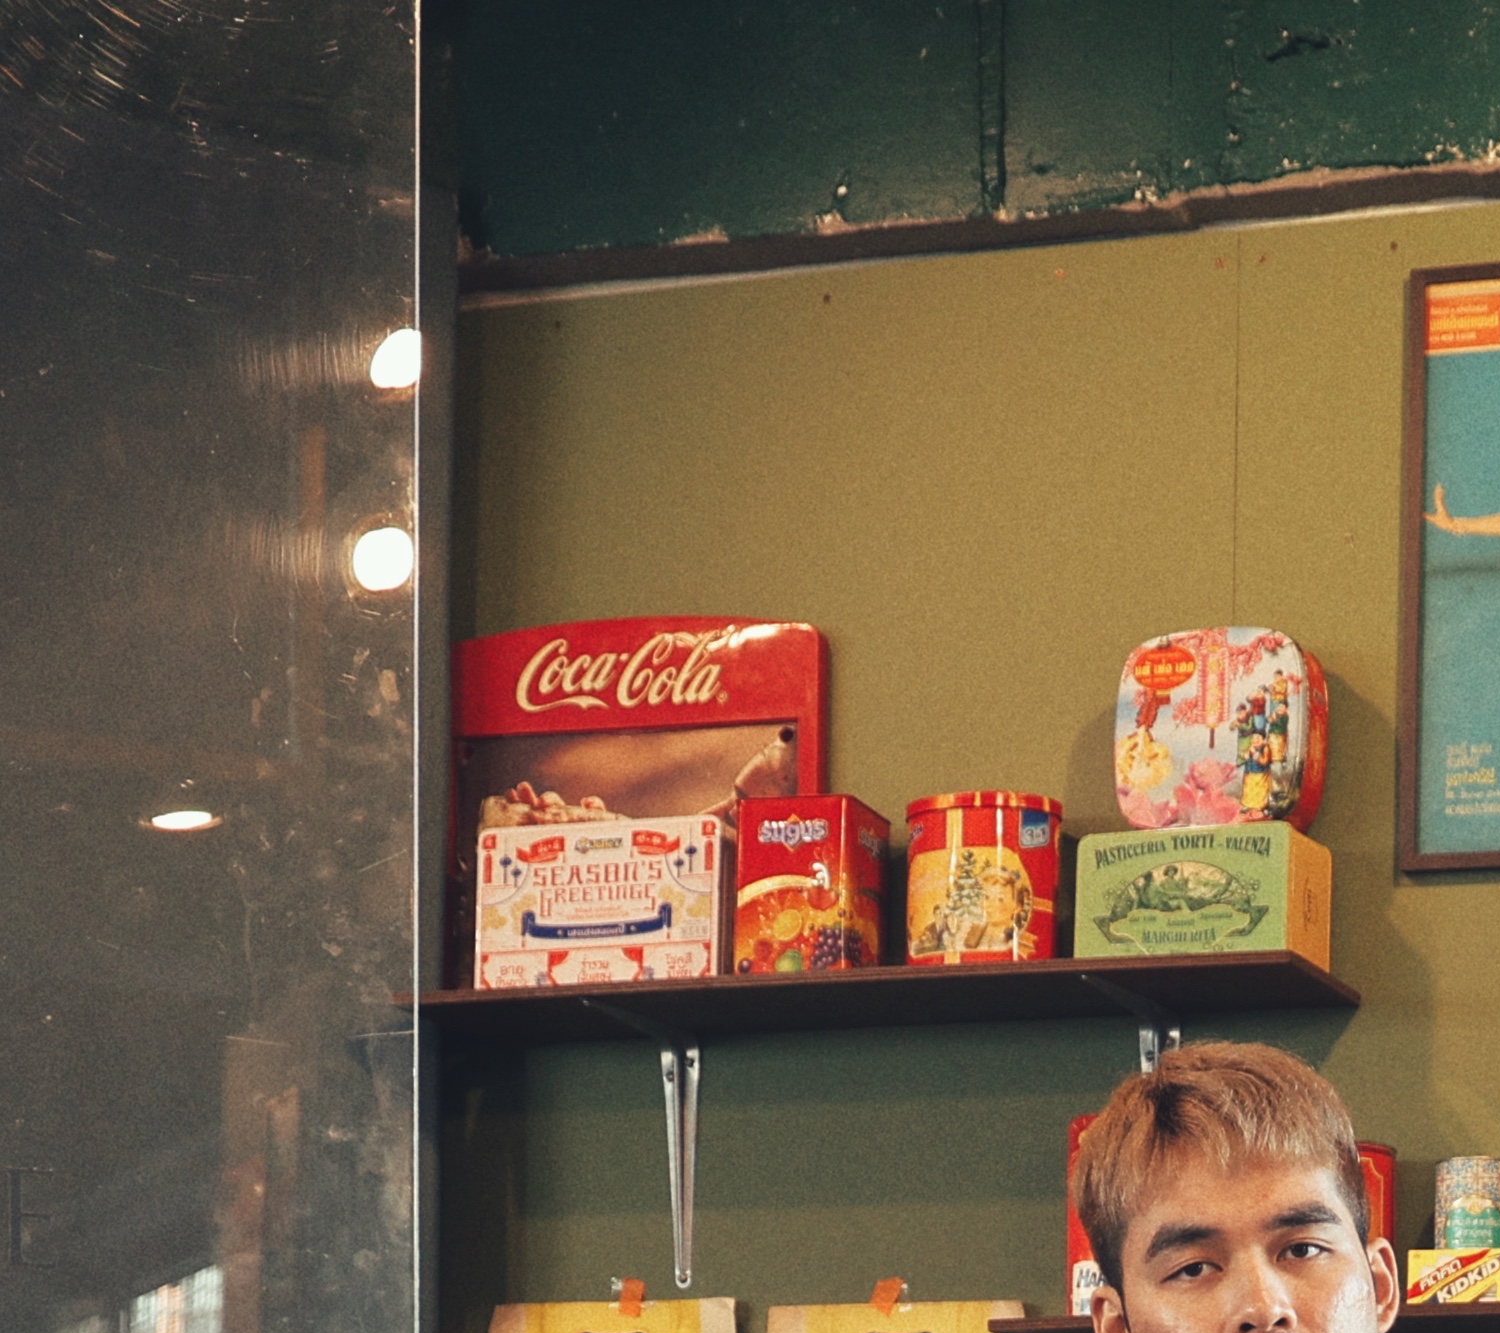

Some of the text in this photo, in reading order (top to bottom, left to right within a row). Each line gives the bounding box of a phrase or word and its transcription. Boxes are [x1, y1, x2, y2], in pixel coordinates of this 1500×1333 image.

[516, 630, 722, 713] Coca-Cola
[758, 819, 828, 845] sugus
[1095, 834, 1271, 869] PASTICCERIA TORTI VALENZA
[533, 860, 662, 886] SEASON'S
[539, 883, 656, 918] GREETINGS
